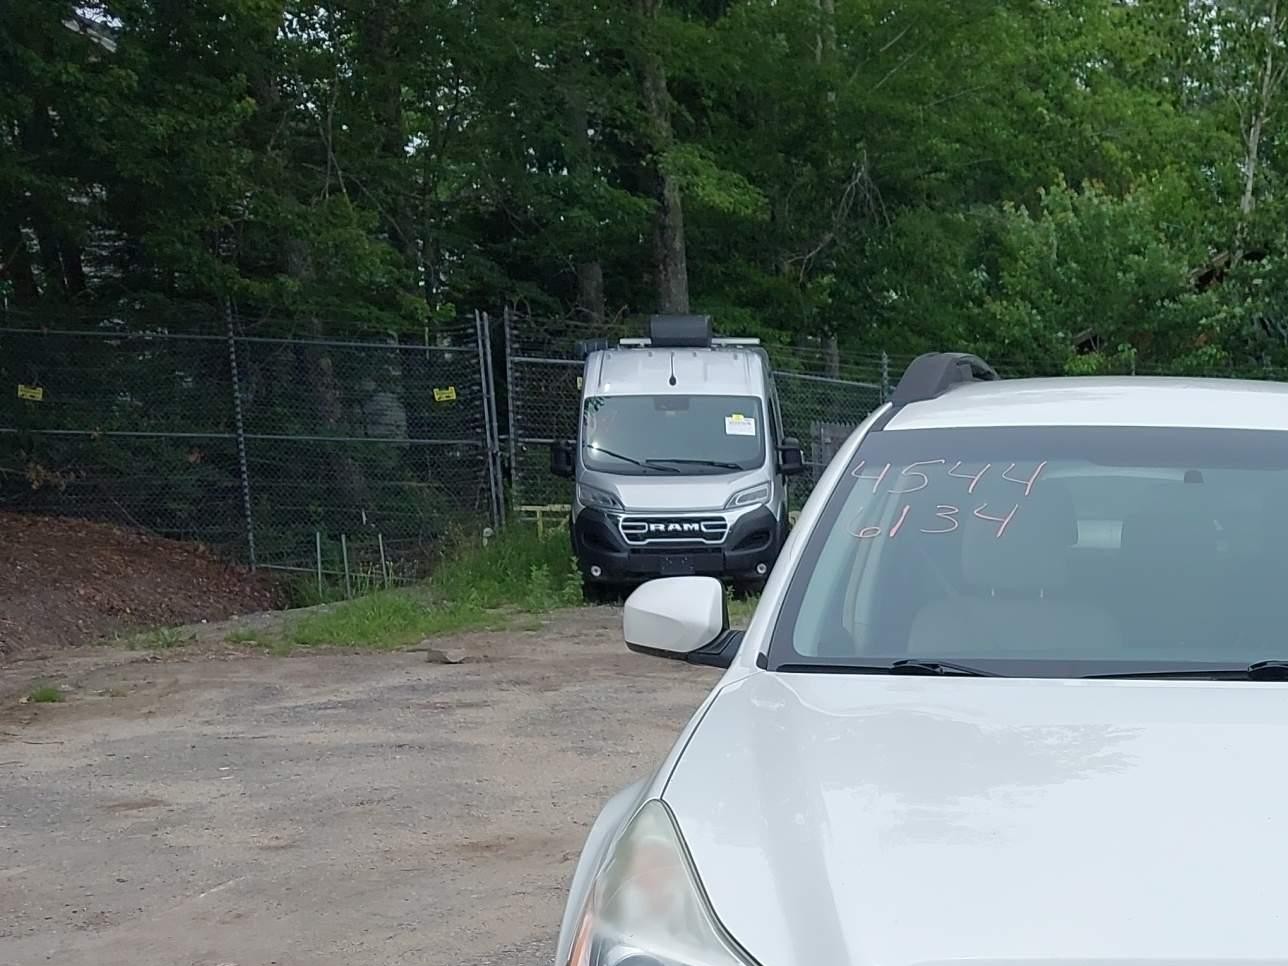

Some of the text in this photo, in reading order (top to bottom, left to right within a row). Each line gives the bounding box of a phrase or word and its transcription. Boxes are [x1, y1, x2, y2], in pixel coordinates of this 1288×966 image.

[851, 460, 1048, 496] 4544
[649, 523, 700, 532] RAM
[847, 504, 1018, 538] 6134
